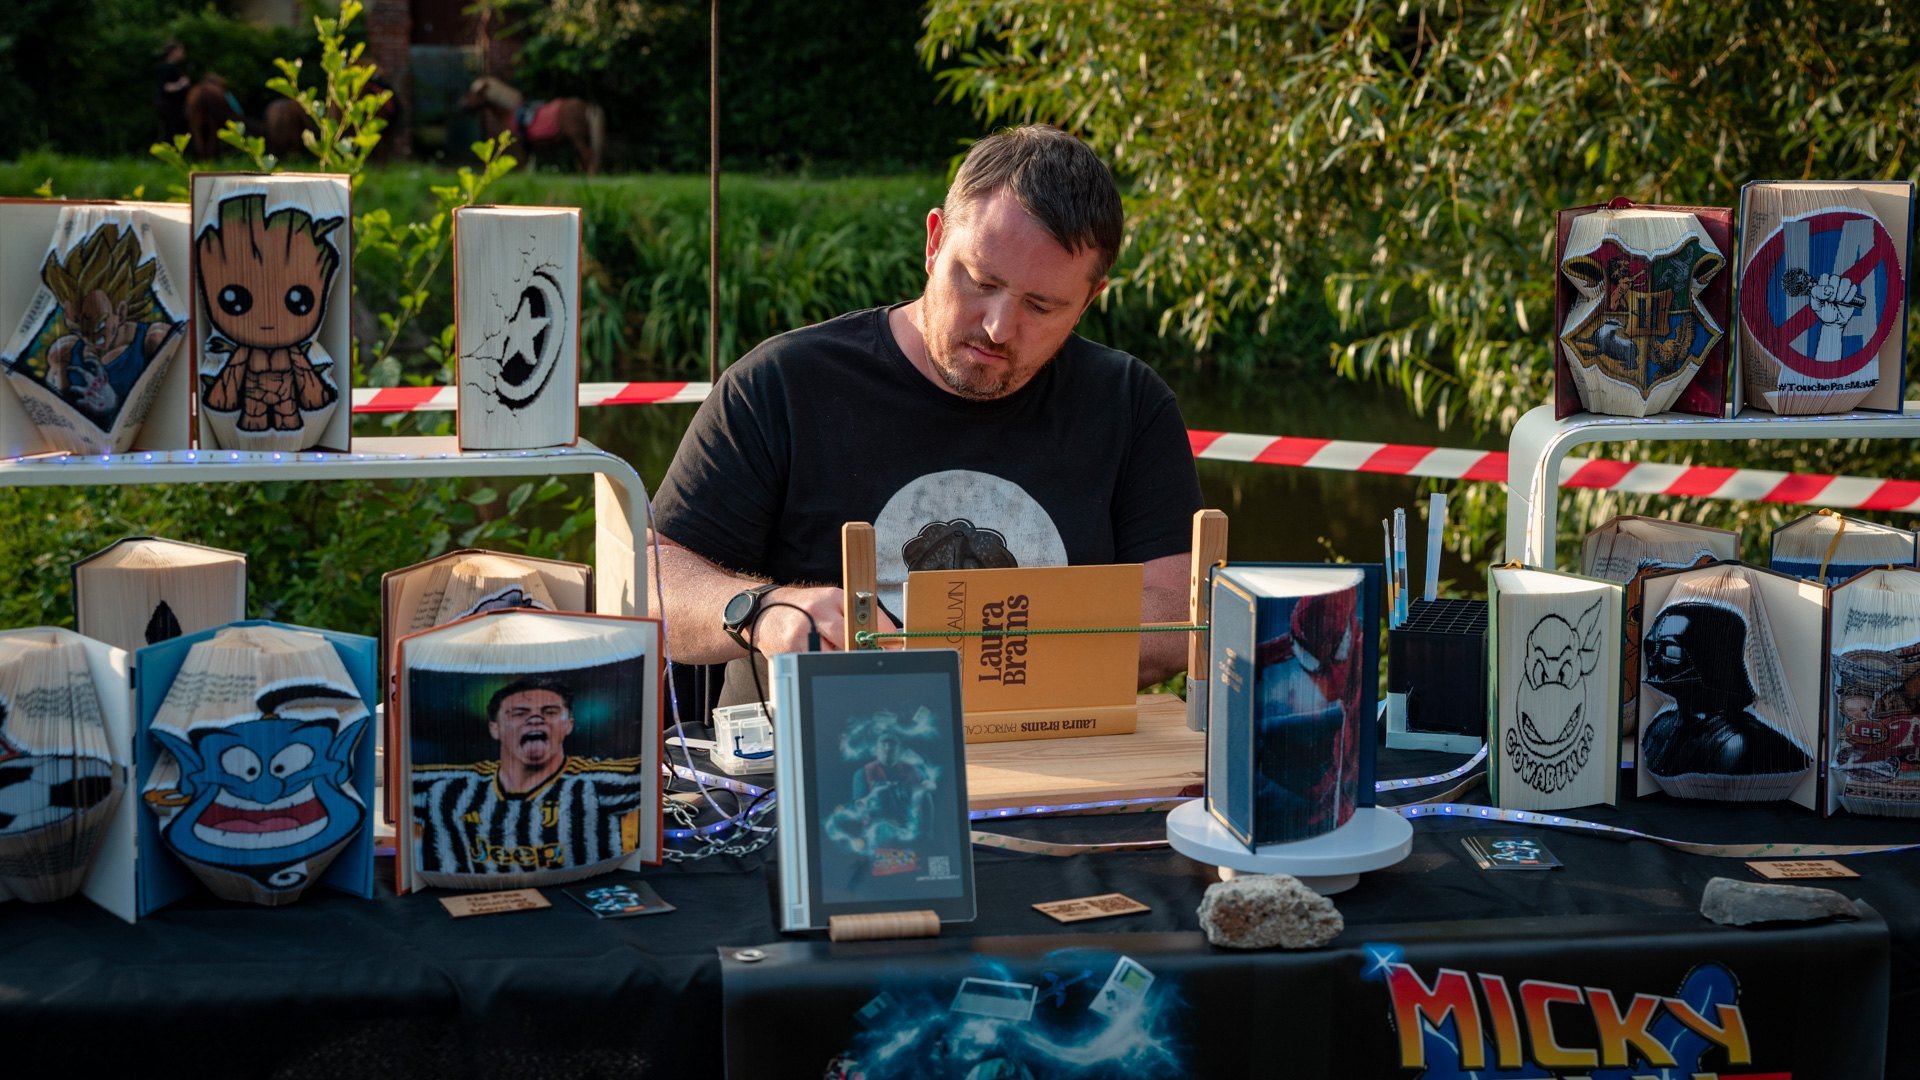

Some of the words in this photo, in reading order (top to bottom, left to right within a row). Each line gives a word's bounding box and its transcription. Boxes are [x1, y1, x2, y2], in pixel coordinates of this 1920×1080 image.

[979, 601, 1005, 682] Laura
[1003, 594, 1029, 685] Brams
[984, 723, 1017, 734] PATRICK
[1020, 720, 1060, 732] Brams
[1063, 718, 1097, 730] Laura
[1851, 723, 1881, 740] Les
[1505, 723, 1595, 794] COWABUNGA
[470, 837, 563, 869] Jeep
[1386, 962, 1752, 1068] MICKY
